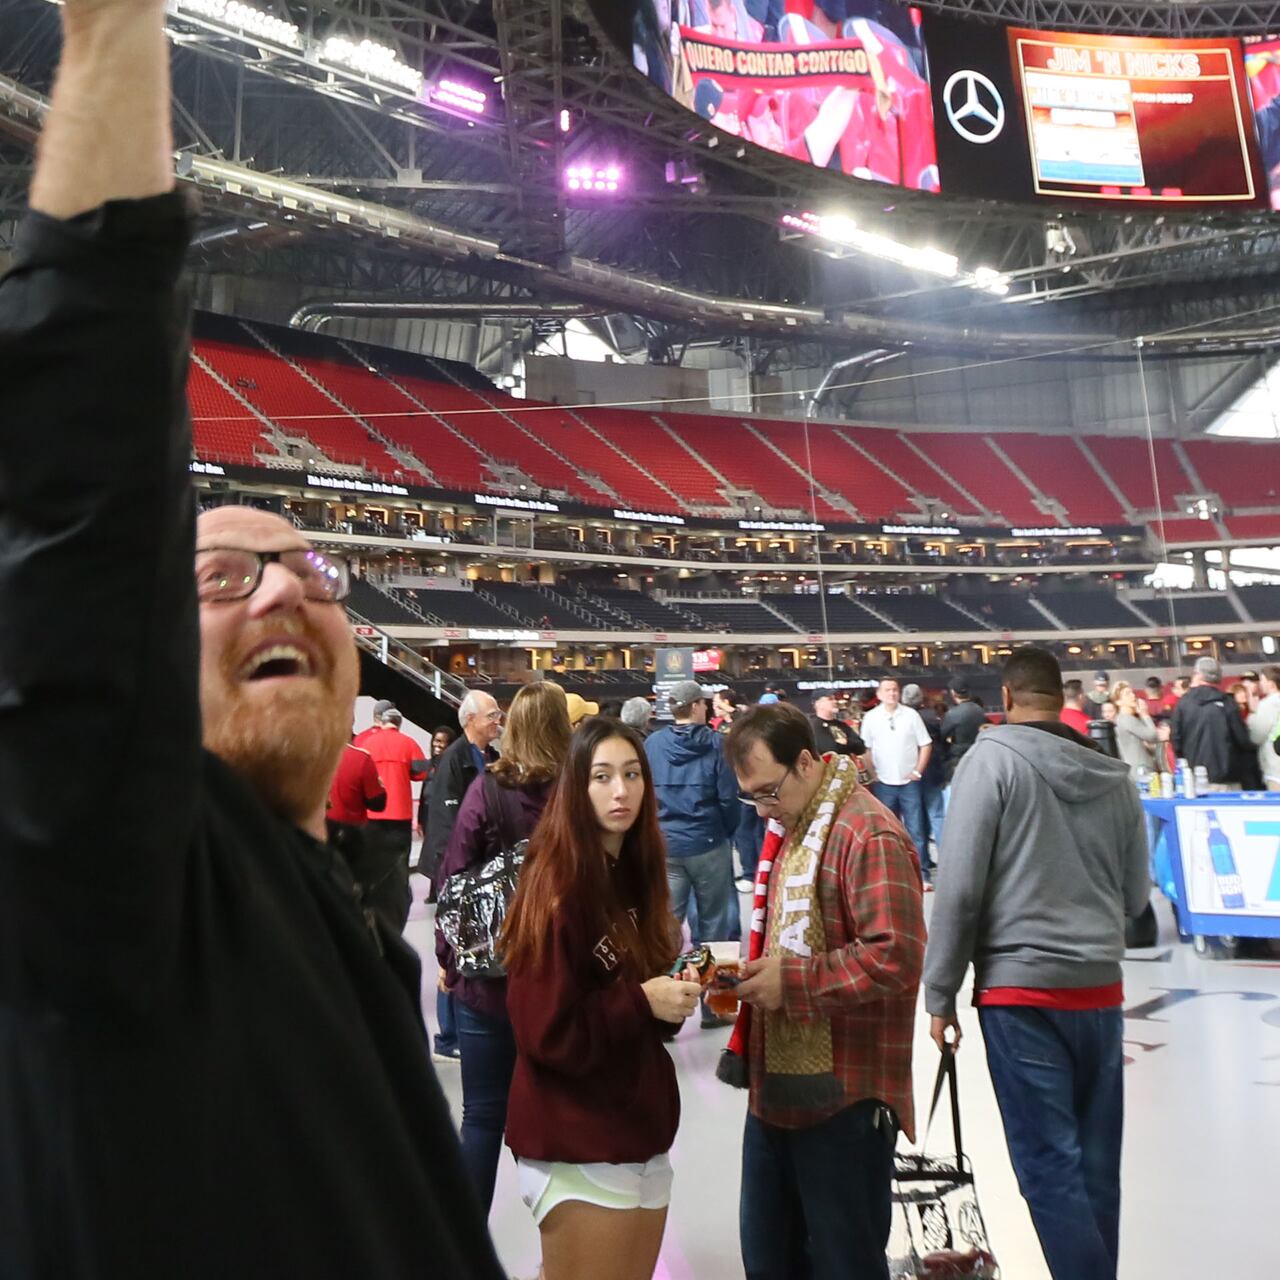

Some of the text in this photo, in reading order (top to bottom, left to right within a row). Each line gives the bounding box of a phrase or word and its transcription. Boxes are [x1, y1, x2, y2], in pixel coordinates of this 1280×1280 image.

[685, 47, 868, 76] QUIERO CONTAR CONTIGO
[1047, 47, 1091, 73] JIM
[1124, 51, 1201, 77] NICKS
